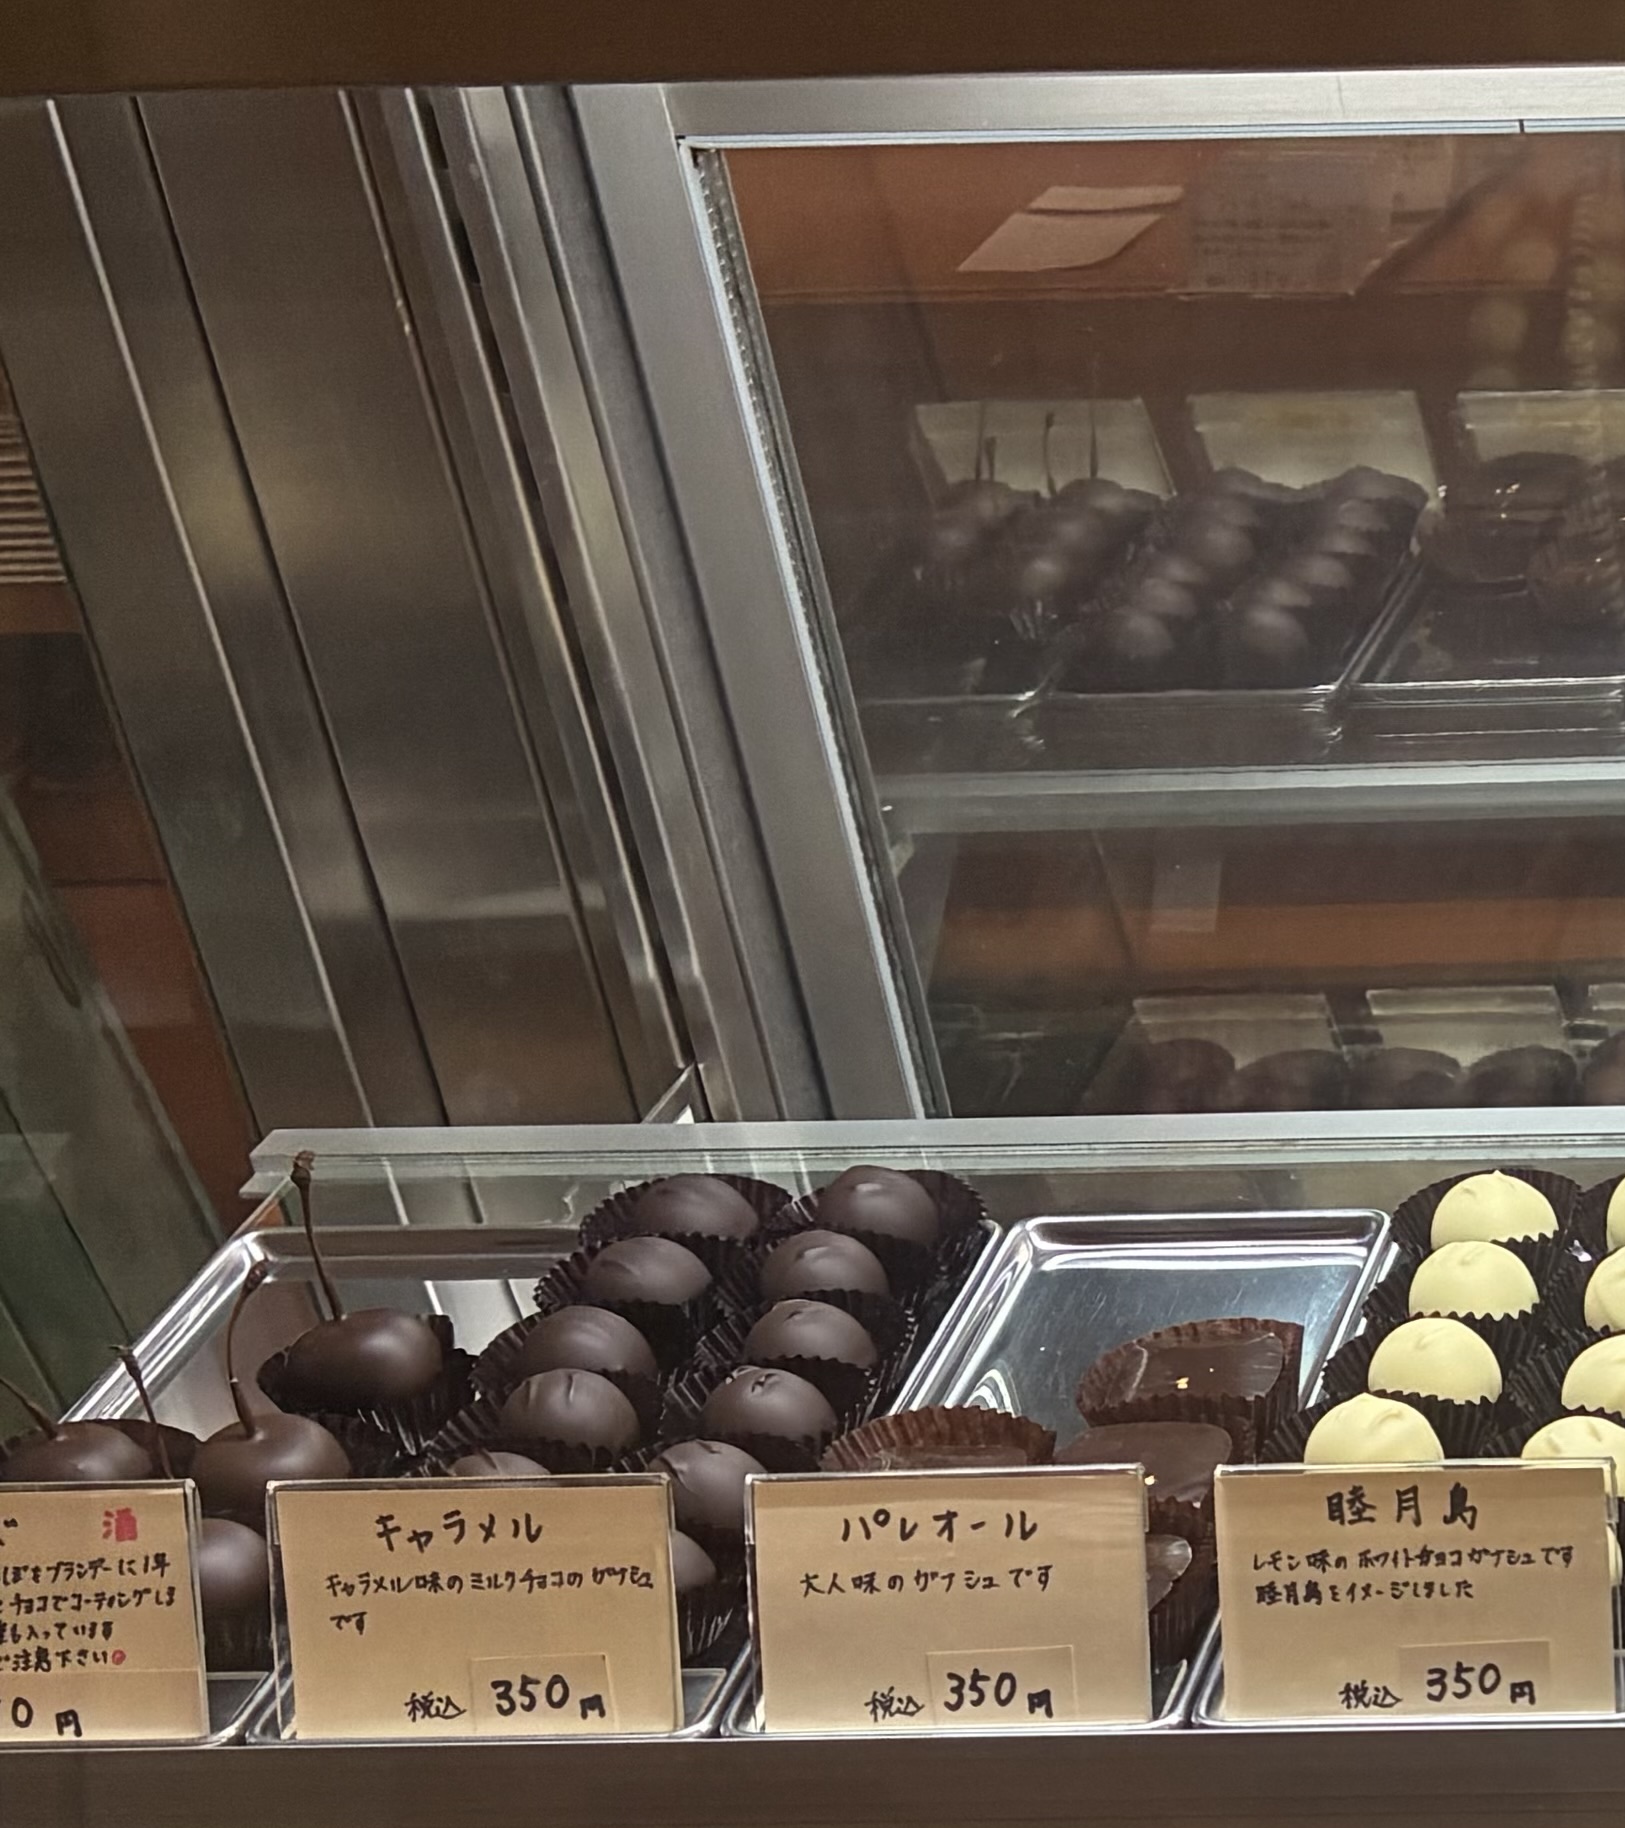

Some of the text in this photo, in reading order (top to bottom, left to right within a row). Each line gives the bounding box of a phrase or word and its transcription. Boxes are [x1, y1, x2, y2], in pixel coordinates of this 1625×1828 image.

[375, 1509, 543, 1553] キャラメル
[841, 1508, 1038, 1543] パレオール
[1326, 1481, 1478, 1531] 睦月島
[329, 1611, 367, 1635] です
[404, 1673, 606, 1723] 税込 350円
[863, 1667, 1054, 1723] 税込 350円
[1338, 1660, 1536, 1710] 税込 350円
